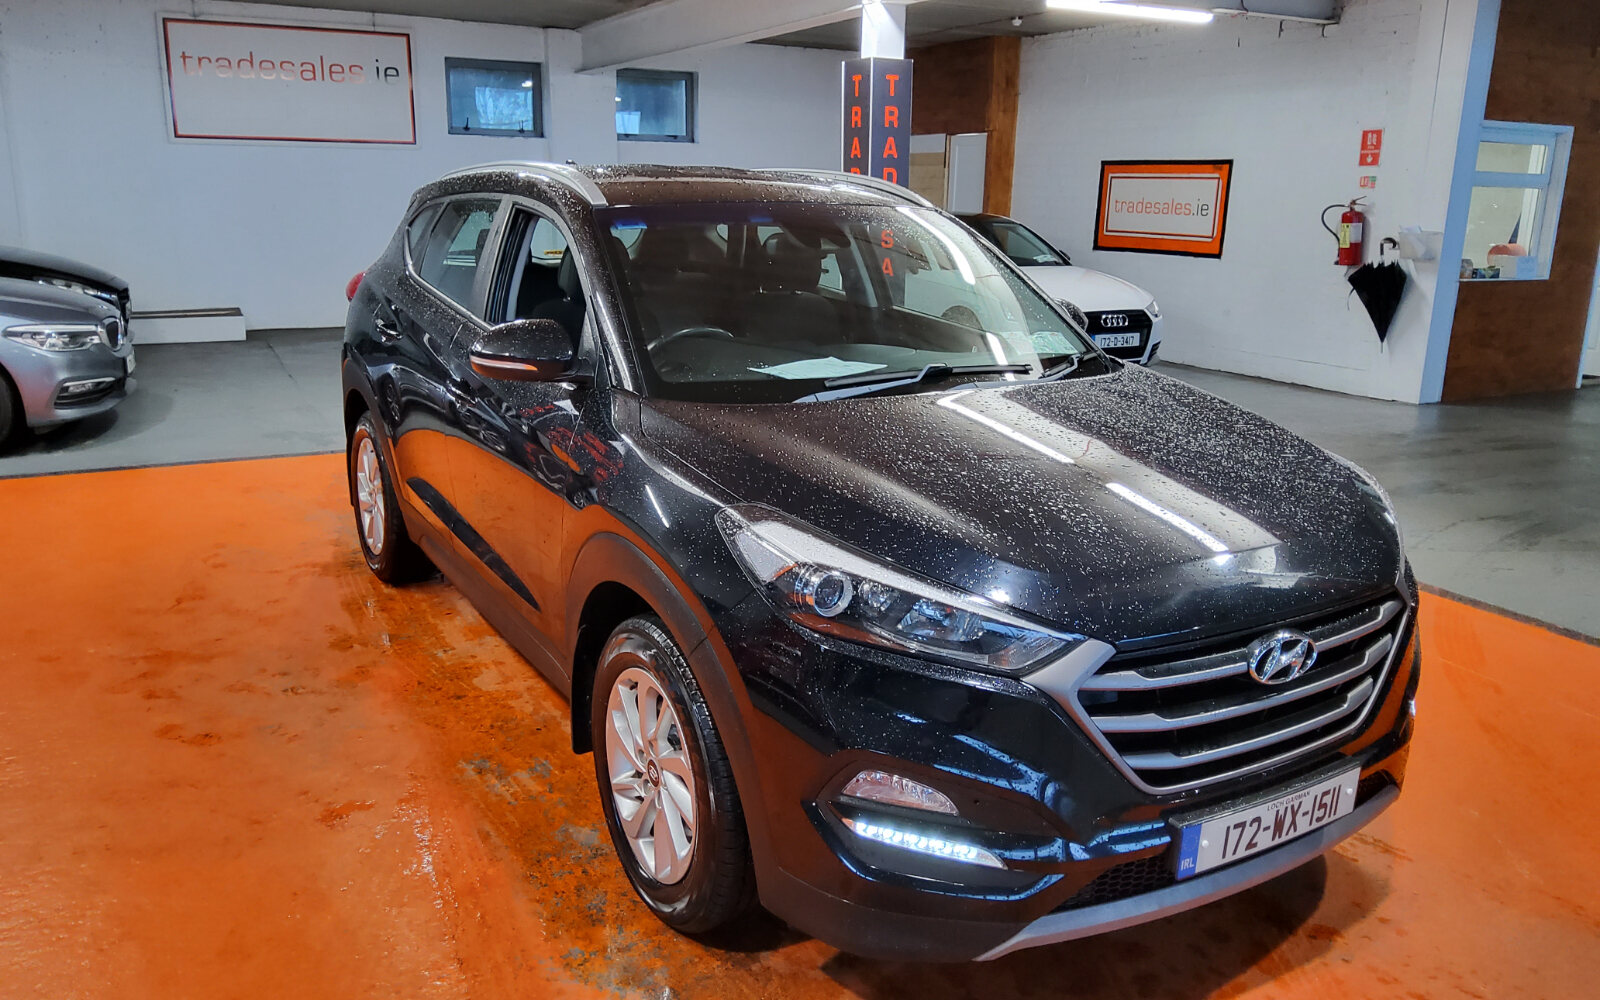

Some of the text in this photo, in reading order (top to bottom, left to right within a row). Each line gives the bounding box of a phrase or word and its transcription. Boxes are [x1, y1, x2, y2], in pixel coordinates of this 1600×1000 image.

[1114, 197, 1210, 217] tradesales.ie
[1100, 336, 1135, 347] 172-D-3417
[1221, 784, 1342, 859] 172-WX-1511
[1180, 858, 1195, 871] IRL
